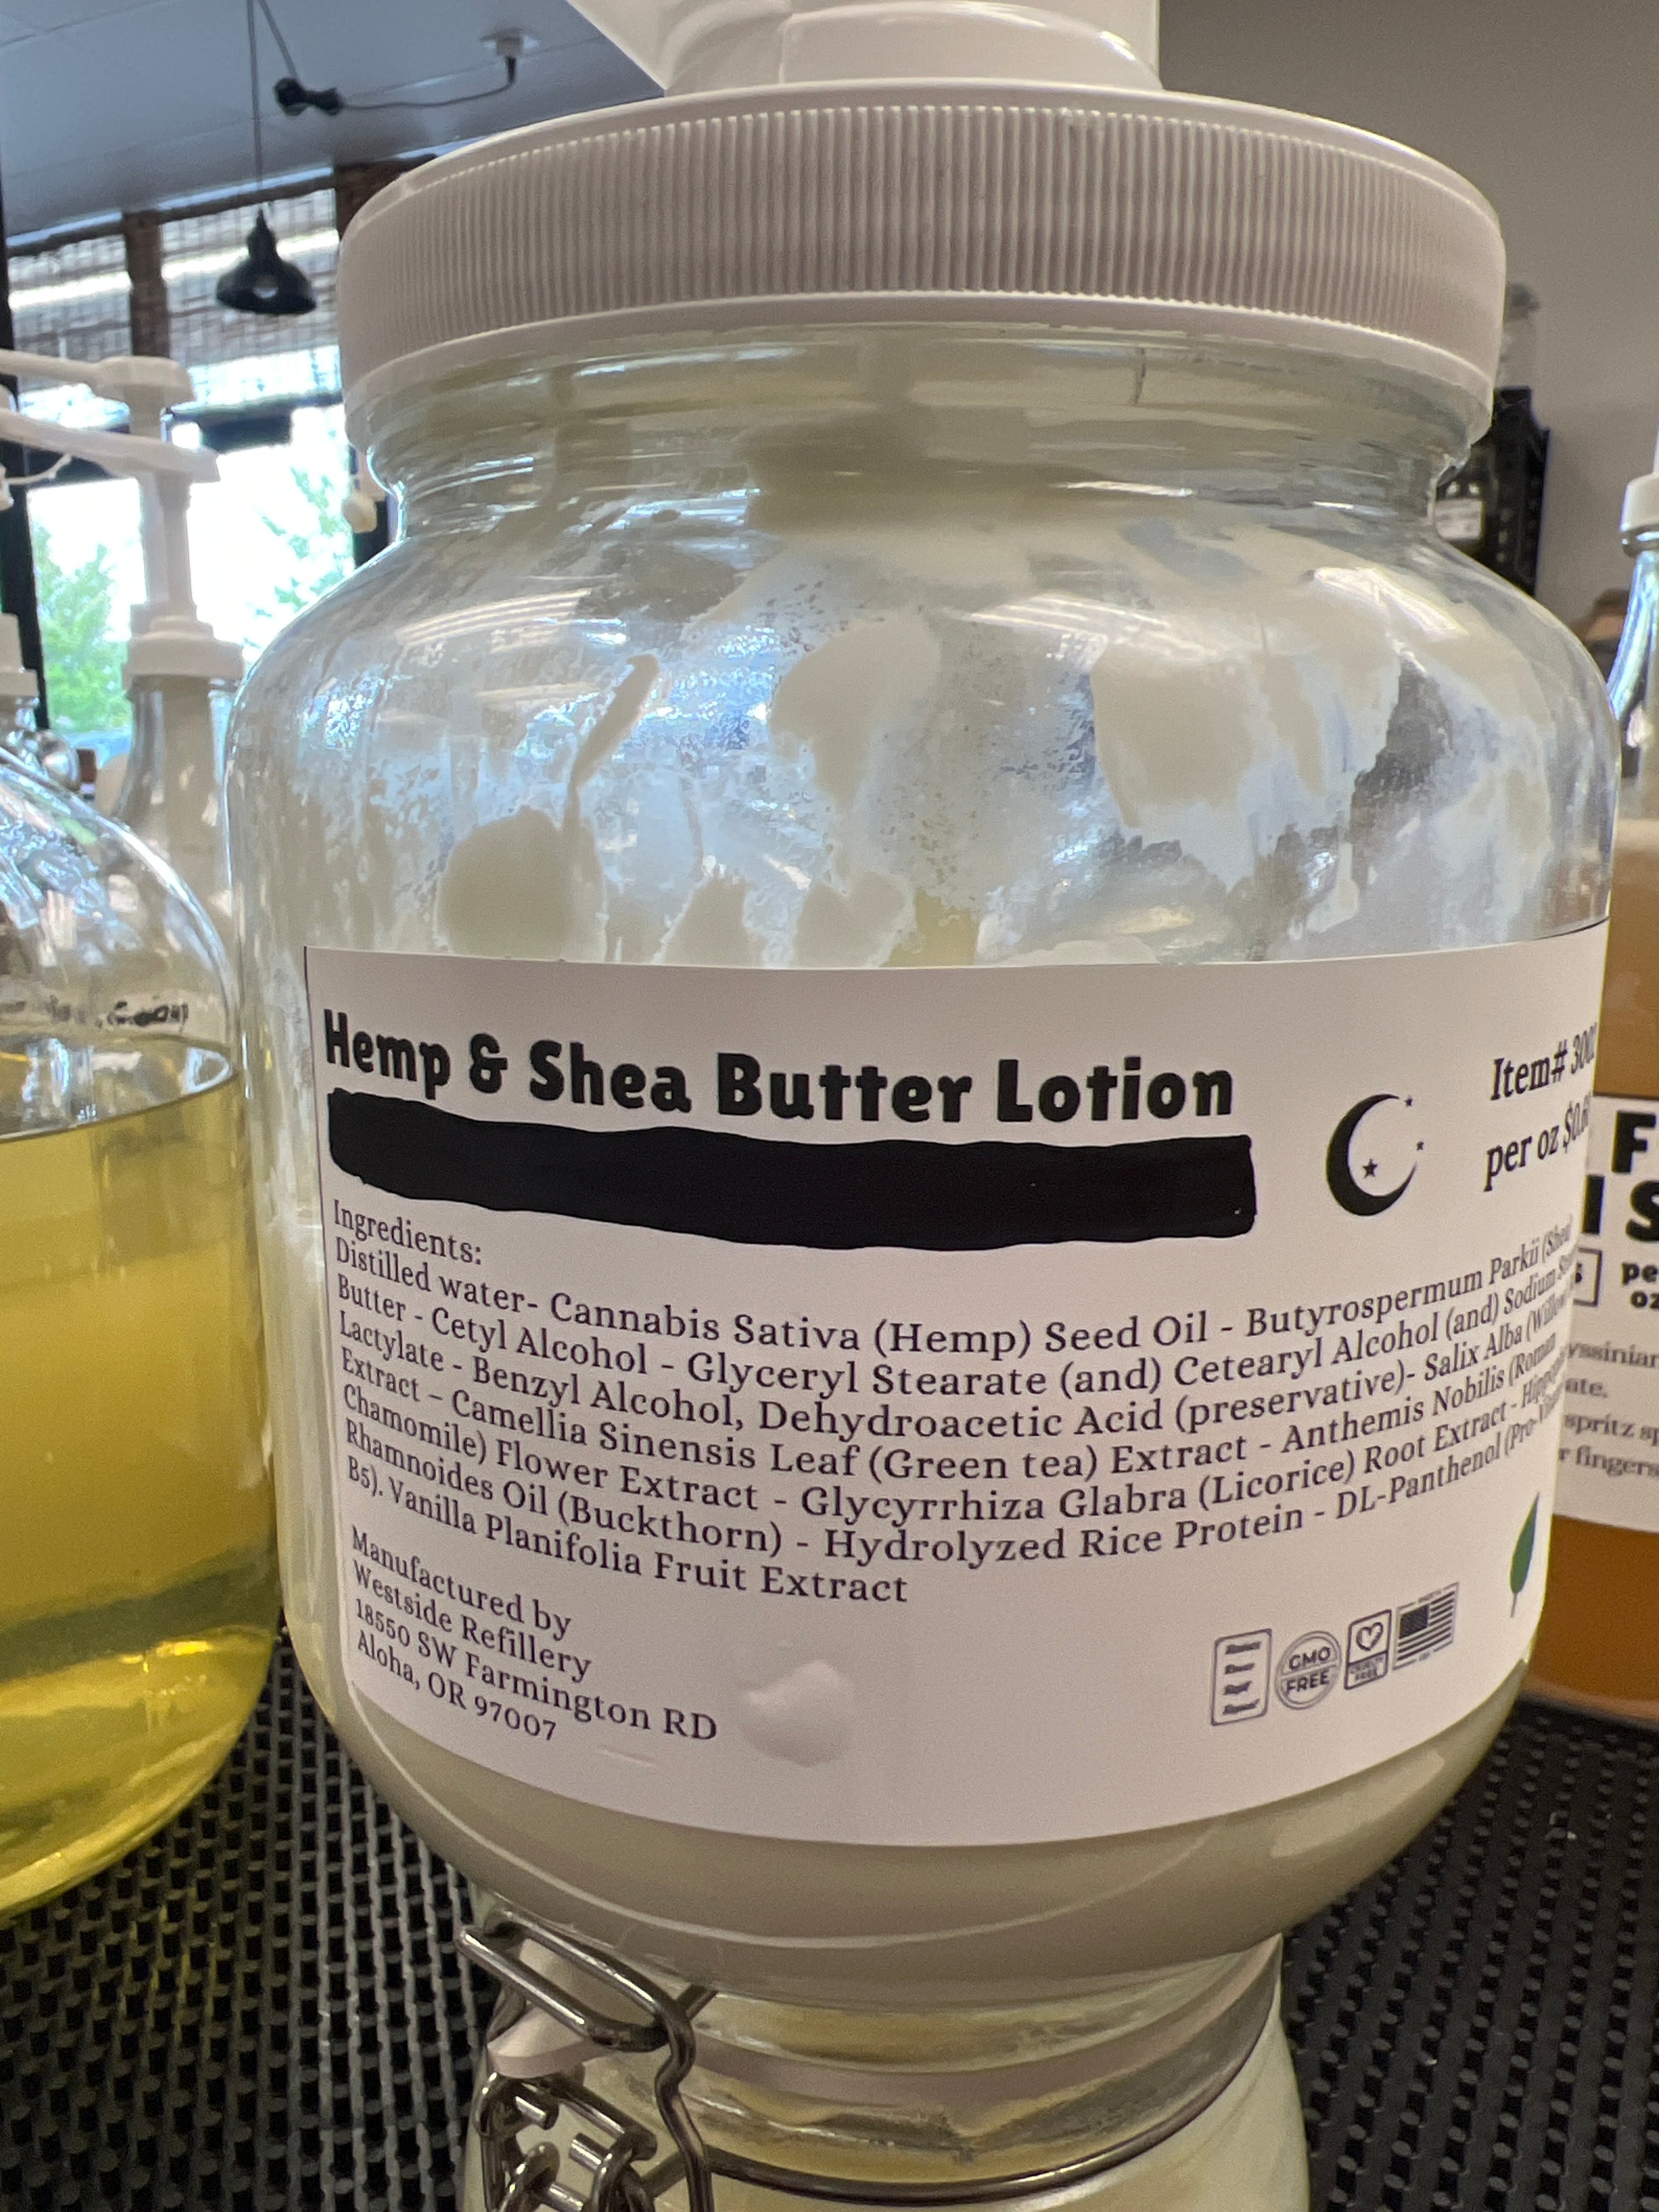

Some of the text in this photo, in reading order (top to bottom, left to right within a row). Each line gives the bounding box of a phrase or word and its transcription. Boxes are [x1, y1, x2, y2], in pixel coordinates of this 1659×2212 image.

[323, 1009, 1233, 1123] Hemp & Shea Butter Lotion
[1490, 1039, 1568, 1101] Item#
[1483, 1136, 1533, 1193] per
[1537, 1125, 1560, 1160] oz
[334, 1199, 481, 1265] Ingredients:
[335, 1237, 432, 1292] Distilled
[438, 1276, 538, 1313] water-
[550, 1293, 719, 1341] Cannabis
[733, 1314, 861, 1351] Sativa
[874, 1319, 1031, 1362] (Hemp)
[1045, 1315, 1142, 1352] Seed
[1153, 1310, 1209, 1346] Oil
[1245, 1271, 1483, 1336] Butyrospermum
[1488, 1237, 1539, 1285] Parkii
[337, 1273, 406, 1322] Butter
[432, 1307, 507, 1353] Cetyl
[515, 1327, 648, 1374] Alcohol
[687, 1351, 859, 1400] Glyceryl
[872, 1364, 1048, 1396] Stearate
[1060, 1357, 1161, 1400] (and)
[1174, 1336, 1323, 1386] Cetearyl
[1330, 1311, 1439, 1365] Alcohol
[1446, 1292, 1499, 1341] (and)
[1504, 1269, 1556, 1315] Sodium
[340, 1310, 444, 1372] Lactylate
[471, 1356, 580, 1408] Benzyl
[590, 1380, 743, 1431] Alcohol,
[758, 1400, 1062, 1443] Dehydroacetic
[1073, 1397, 1163, 1435] Acid
[1424, 1341, 1480, 1381] Salix
[1483, 1323, 1522, 1360] Alba
[341, 1345, 420, 1402] Extract
[452, 1389, 588, 1446] Camellia
[599, 1423, 755, 1469] Sinensis
[770, 1443, 861, 1476] Leaf
[868, 1445, 1009, 1485] (Green
[1022, 1444, 1097, 1482] tea)
[1110, 1436, 1248, 1476] Extract
[1280, 1396, 1424, 1453] Anthemis
[1431, 1365, 1504, 1416] Nobilis
[343, 1384, 487, 1465] Chamomile)
[495, 1439, 608, 1489] Flower
[619, 1465, 759, 1511] Extract
[802, 1485, 1045, 1526] Glycyrrhiza
[1059, 1482, 1187, 1518] Glabra
[1199, 1448, 1355, 1511] (Licorice)
[1363, 1435, 1426, 1474] Root
[1432, 1401, 1507, 1452] Extract
[346, 1417, 494, 1503] Rhamnoides
[503, 1480, 548, 1516] Oil
[558, 1491, 782, 1558] (Buckthorn)
[825, 1526, 1066, 1570] Hydrolyzed
[1079, 1525, 1162, 1558] Rice
[1173, 1503, 1302, 1549] Protein
[1334, 1431, 1501, 1520] DL-Panthenol
[352, 1525, 572, 1641] Manufactured by
[388, 1475, 476, 1534] Vanilla
[485, 1513, 642, 1576] Planifolia
[654, 1551, 747, 1591] Fruit
[760, 1565, 908, 1602] Extract
[352, 1560, 592, 1682] Westside Refillery
[356, 1599, 716, 1740] 18550 SW Farmington RD
[1287, 1670, 1329, 1695] FREE
[358, 1630, 556, 1741] Aloha, OR 97007
